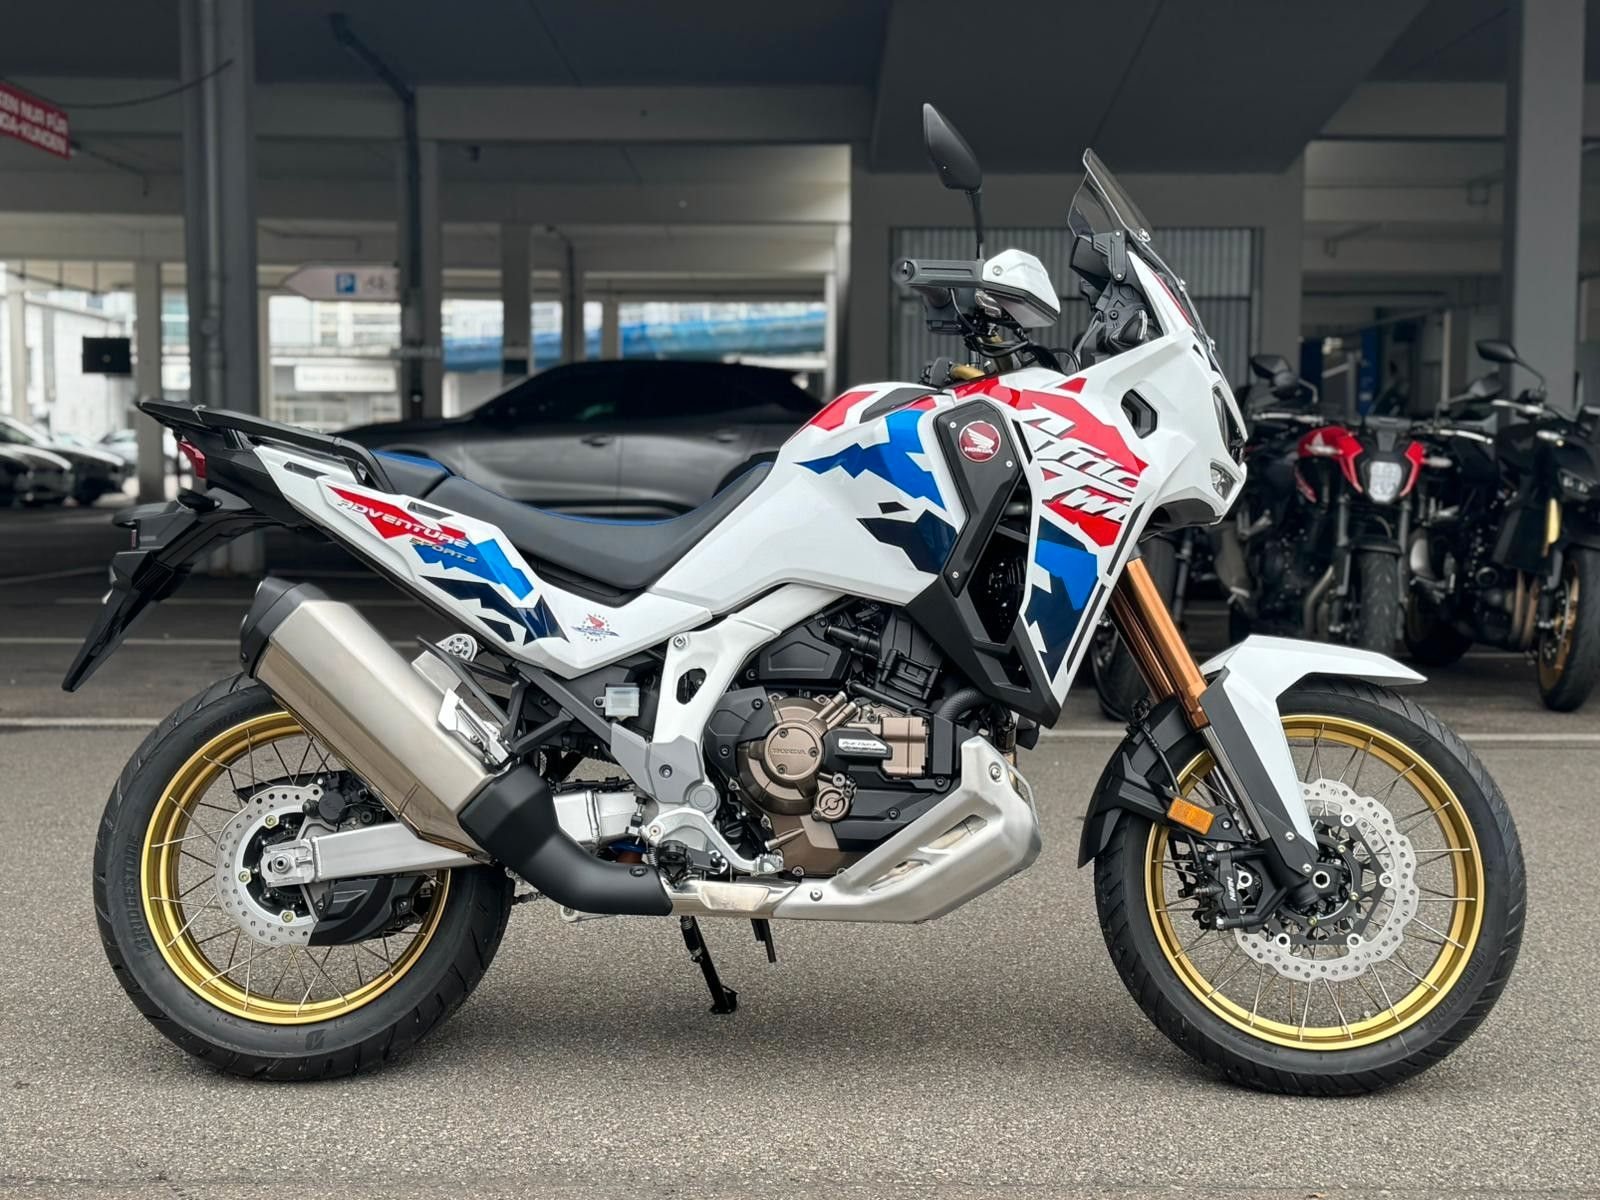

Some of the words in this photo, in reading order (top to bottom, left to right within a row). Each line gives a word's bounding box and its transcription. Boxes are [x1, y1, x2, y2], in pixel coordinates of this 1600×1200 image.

[964, 445, 995, 455] HONDA
[409, 537, 478, 563] SPORTS
[769, 747, 807, 756] HONDA
